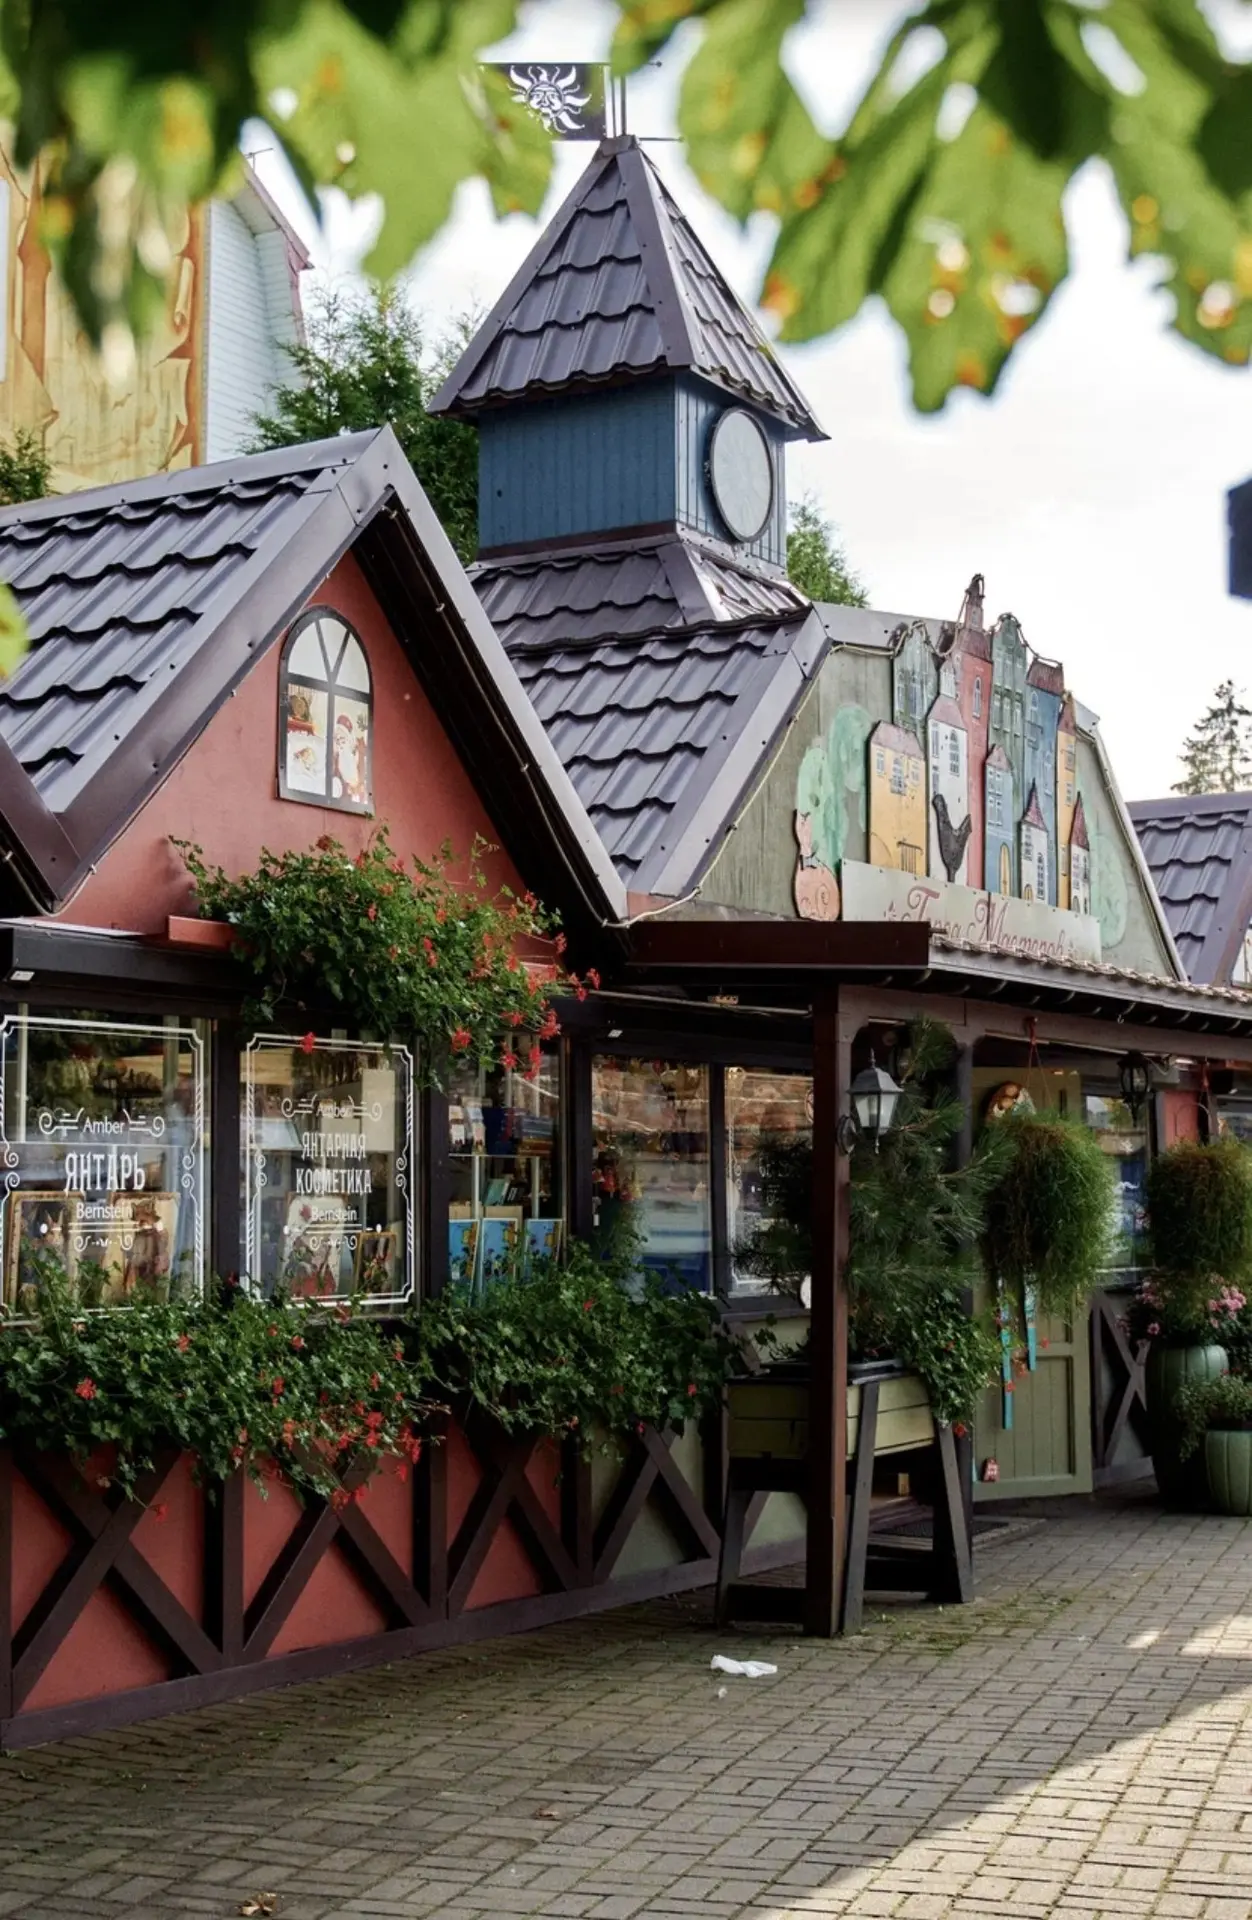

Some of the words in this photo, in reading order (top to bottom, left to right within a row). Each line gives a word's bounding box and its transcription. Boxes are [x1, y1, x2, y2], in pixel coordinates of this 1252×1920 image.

[315, 1102, 352, 1118] Amber
[83, 1116, 125, 1134] Amber
[301, 1132, 367, 1160] ЯНТАРНАЯ
[64, 1151, 146, 1195] ЯНТАРЬ
[295, 1167, 372, 1196] КОСМЕТИКА
[76, 1201, 133, 1219] Bernstein
[311, 1205, 358, 1222] Bernstein
